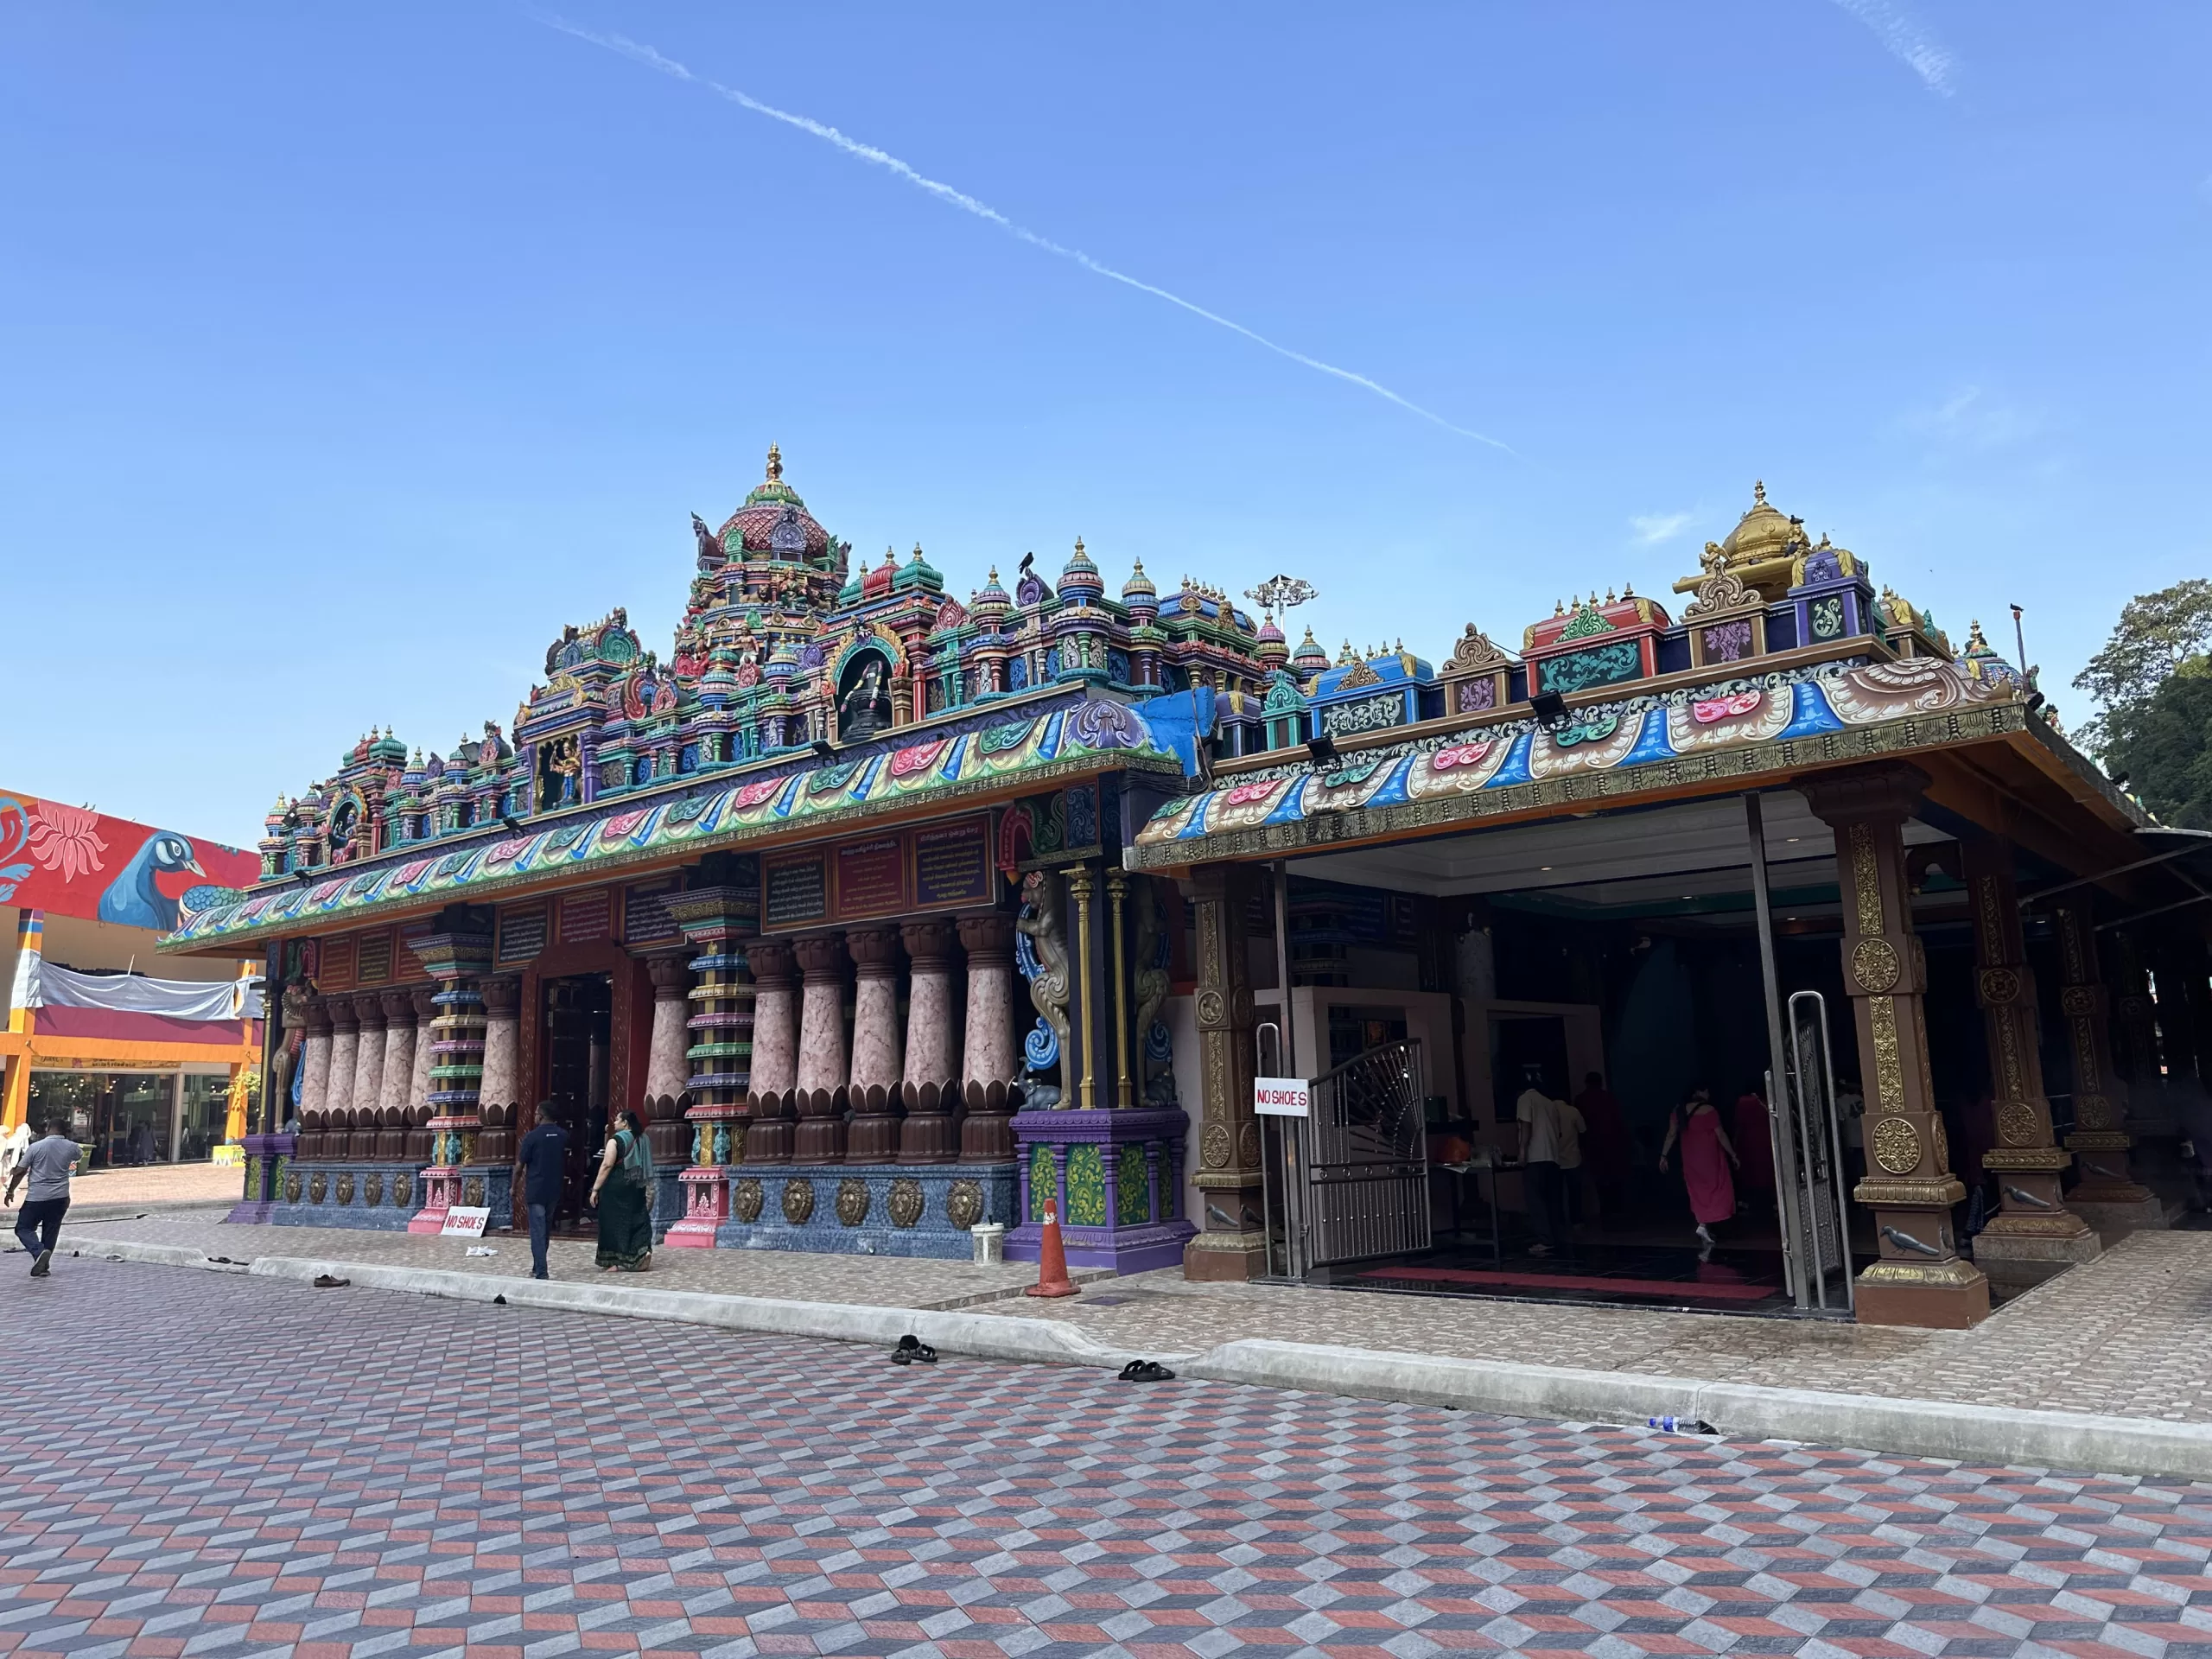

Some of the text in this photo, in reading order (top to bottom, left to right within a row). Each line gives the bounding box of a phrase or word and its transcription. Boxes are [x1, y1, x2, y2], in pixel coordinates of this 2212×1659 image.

[1257, 1089, 1306, 1106] NO SHOES
[446, 1215, 485, 1230] NO SHOES
